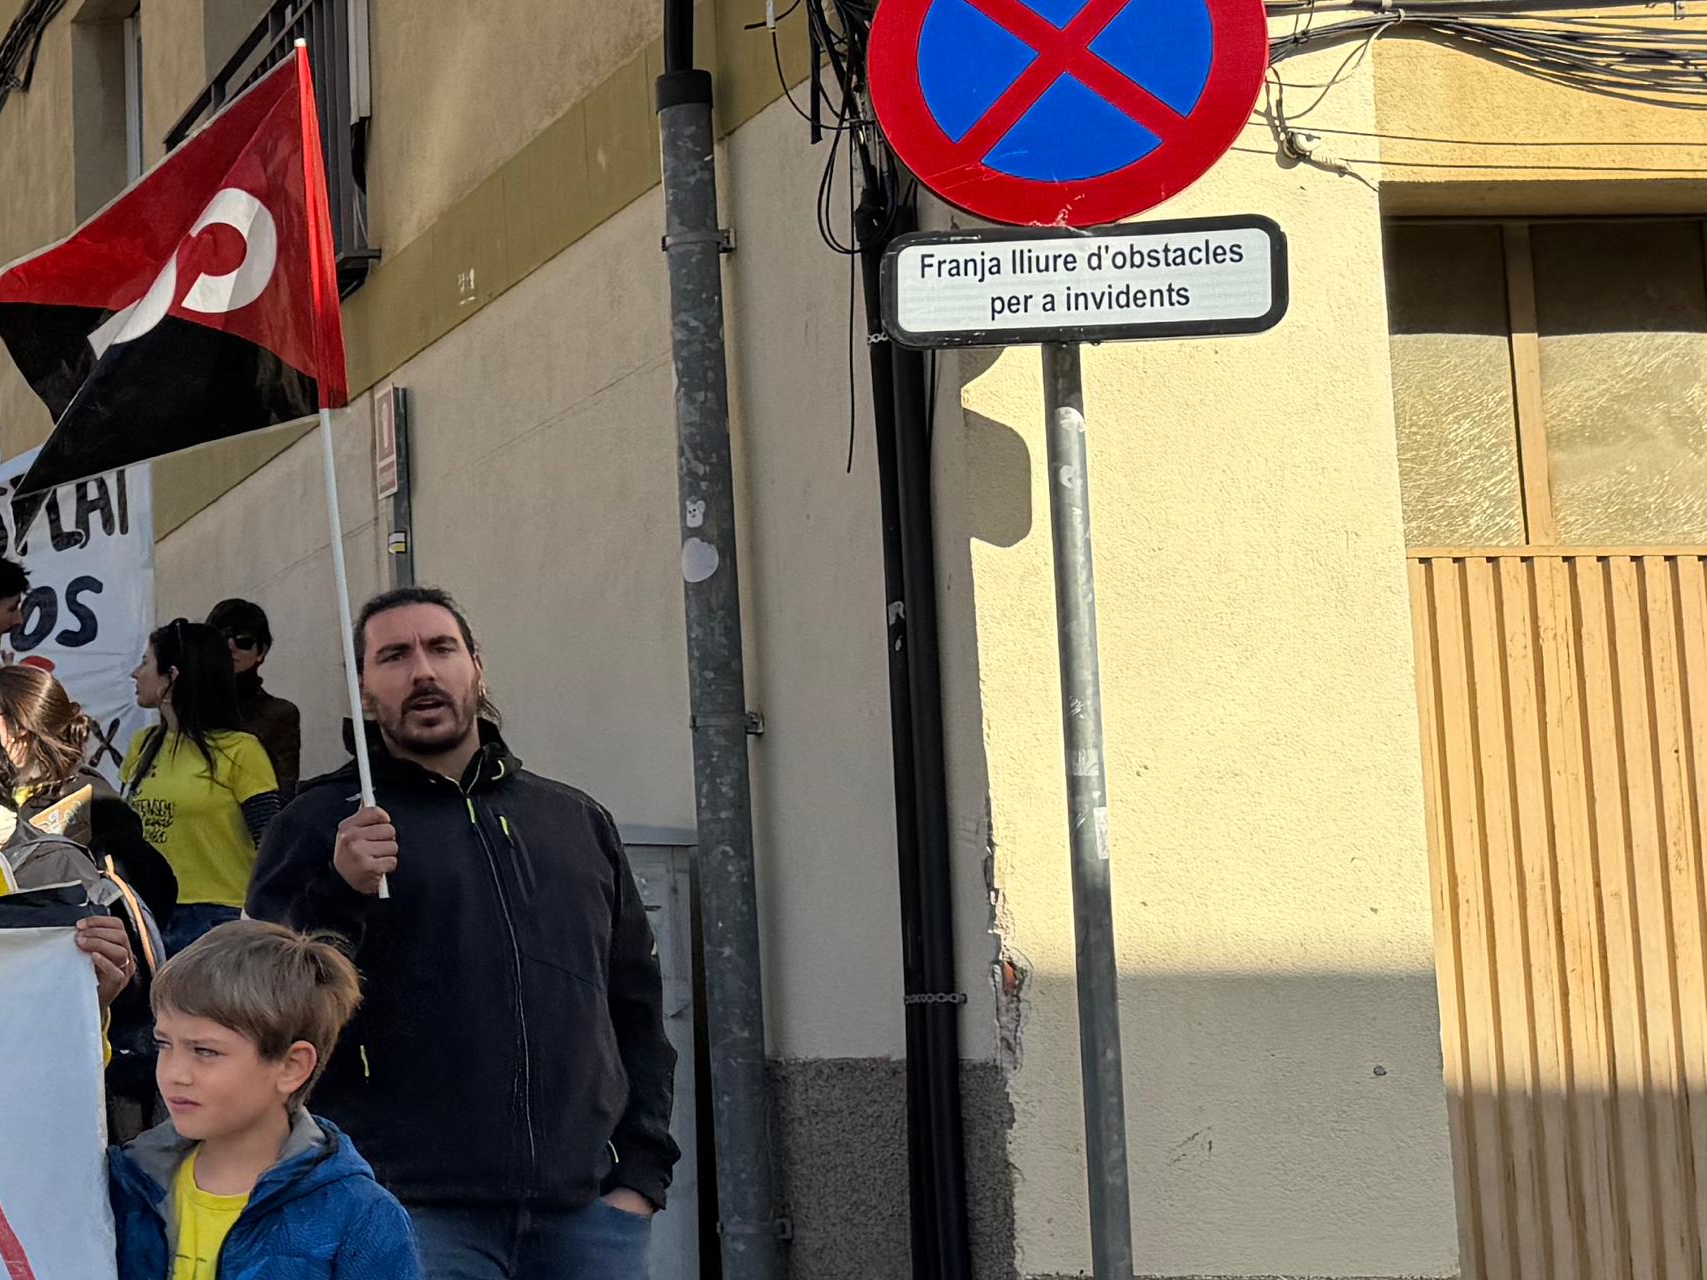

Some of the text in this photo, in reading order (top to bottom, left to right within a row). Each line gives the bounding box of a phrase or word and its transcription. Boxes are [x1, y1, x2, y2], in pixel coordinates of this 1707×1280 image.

[920, 239, 1244, 282] Franja lliure d'obstacles
[990, 282, 1191, 320] per a invidents
